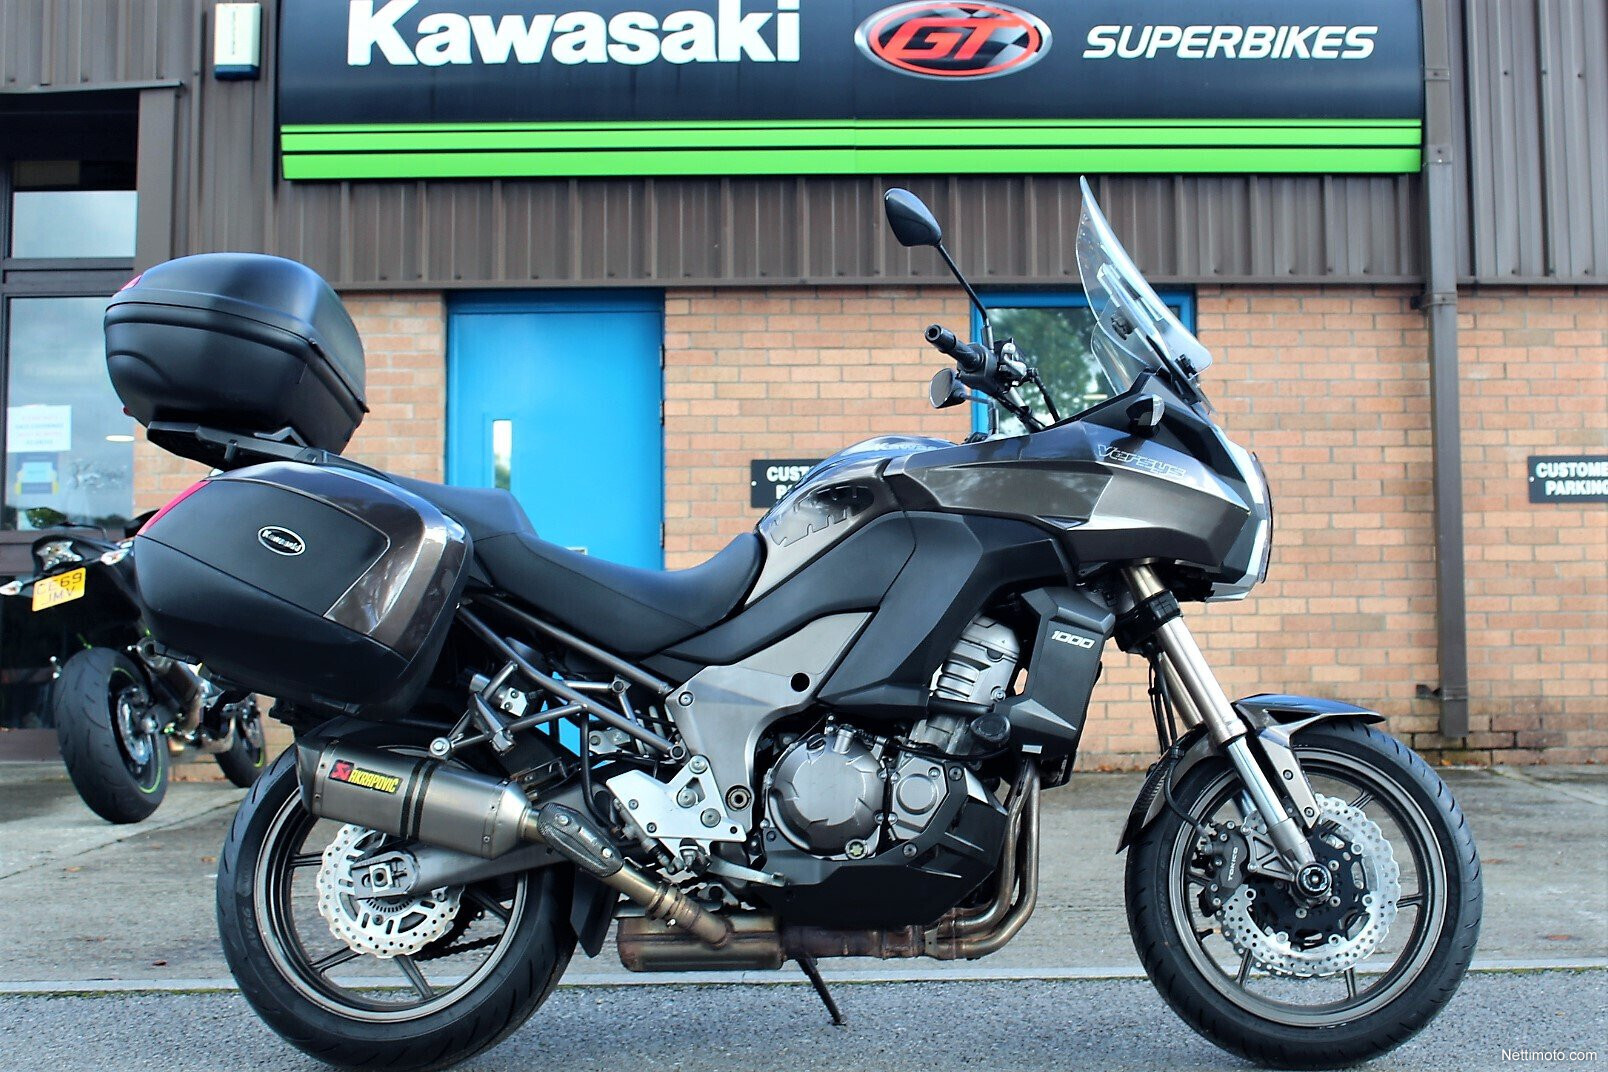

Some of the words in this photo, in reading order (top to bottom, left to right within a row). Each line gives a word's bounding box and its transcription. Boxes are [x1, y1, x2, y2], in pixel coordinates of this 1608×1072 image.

[347, 0, 800, 66] Kawasaki
[884, 17, 1023, 60] GT
[1083, 25, 1378, 59] SUPERBIKES
[766, 465, 814, 482] CUST
[775, 484, 793, 500] P
[1051, 630, 1096, 649] 1000
[1227, 846, 1239, 882] TOKICO
